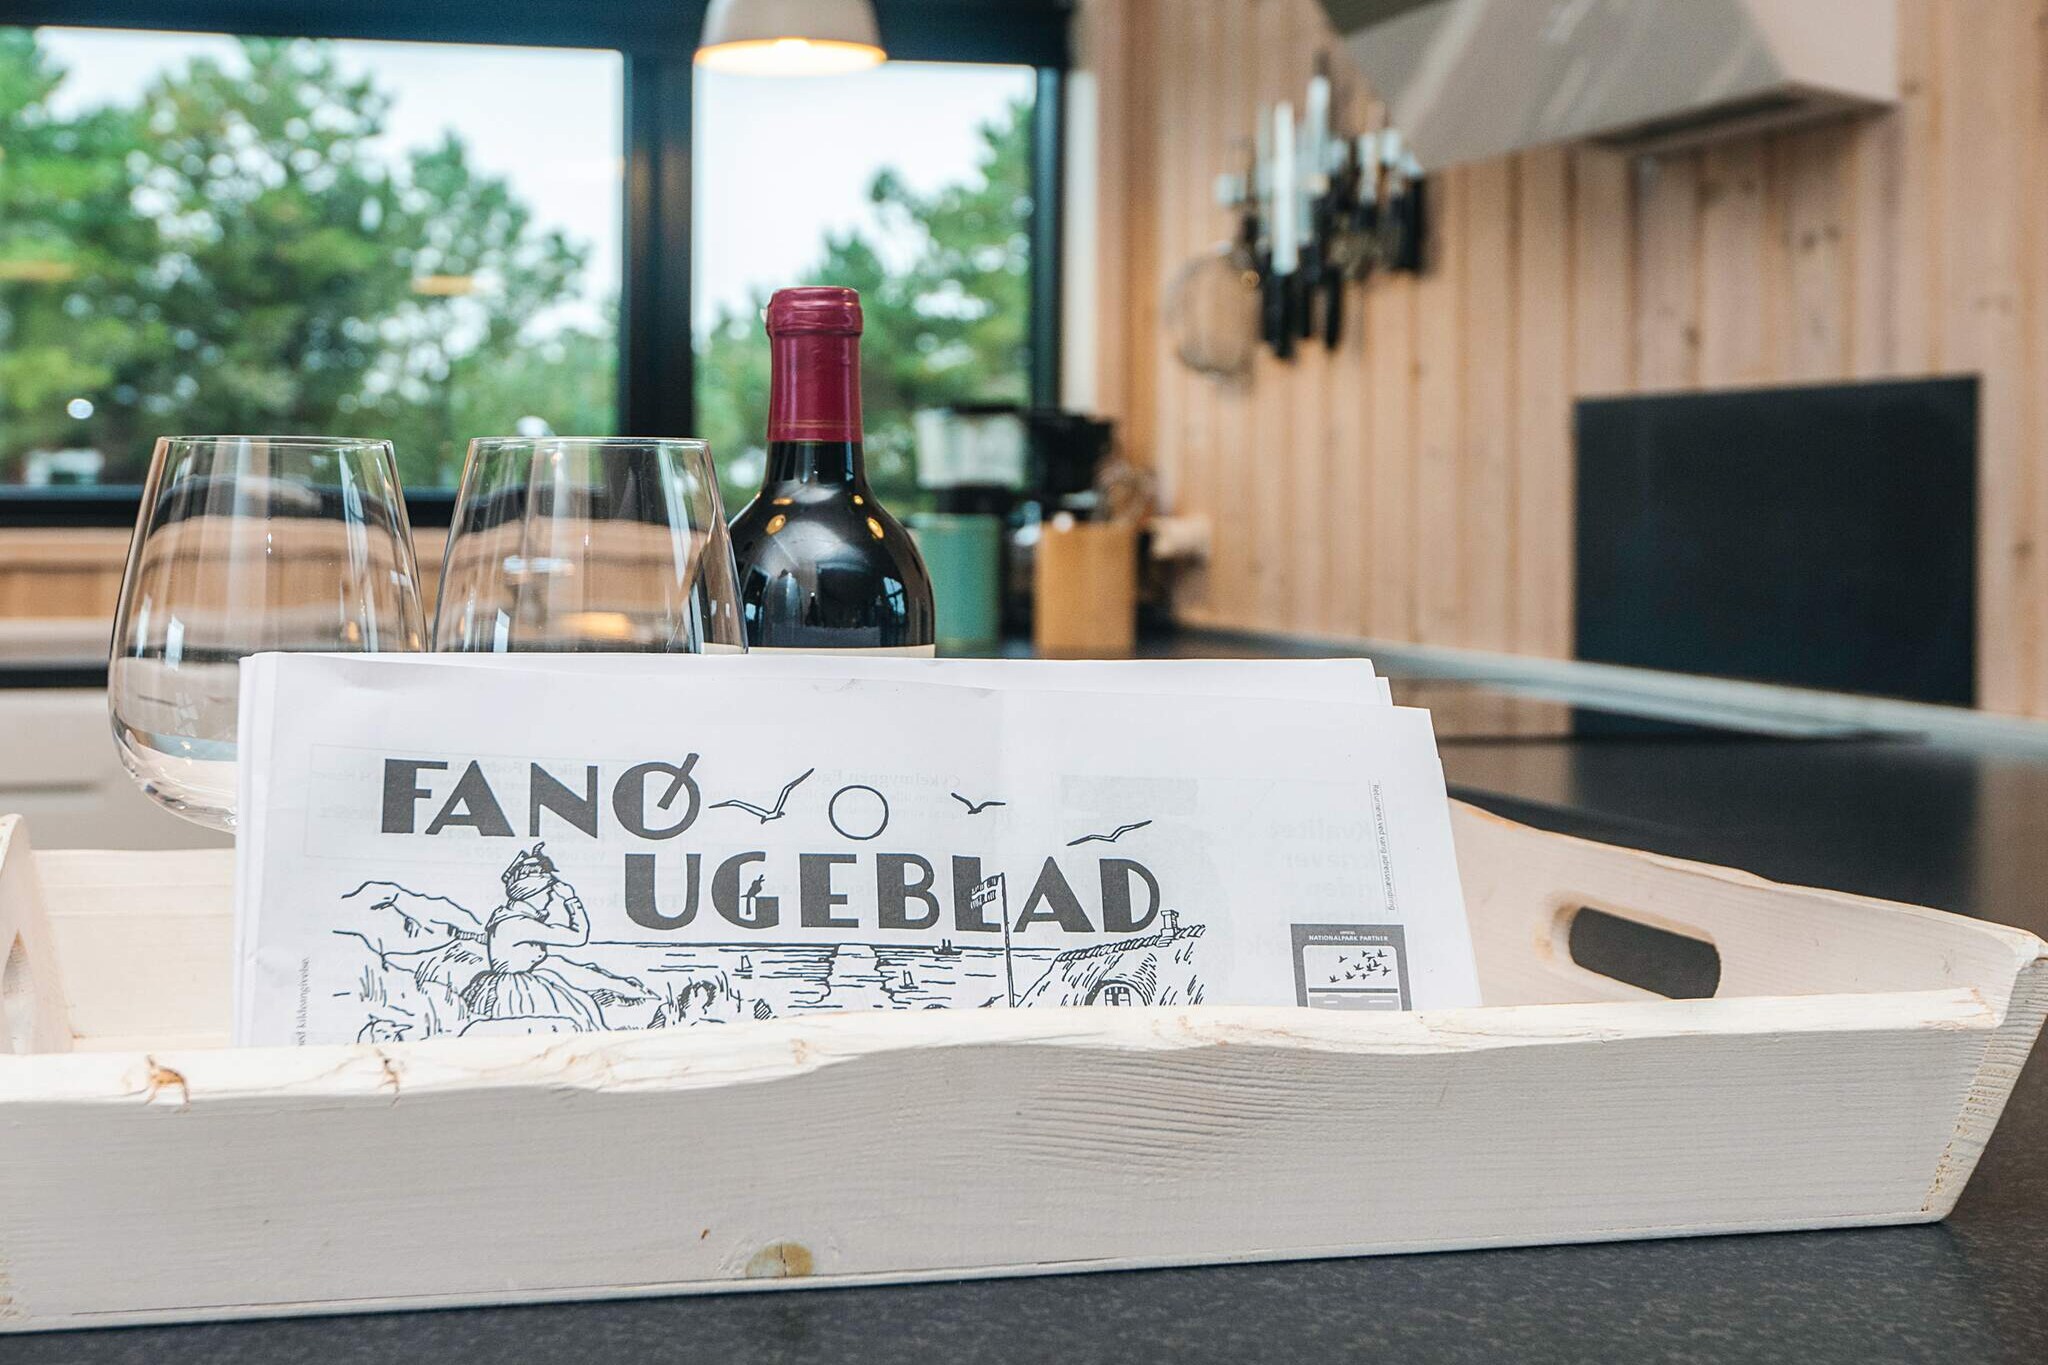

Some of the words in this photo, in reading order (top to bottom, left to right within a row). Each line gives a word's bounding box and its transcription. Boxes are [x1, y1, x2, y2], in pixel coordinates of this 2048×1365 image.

[381, 752, 701, 841] FANØ
[624, 851, 1162, 933] UGEBLAD
[1308, 934, 1359, 942] NATIONALPARK
